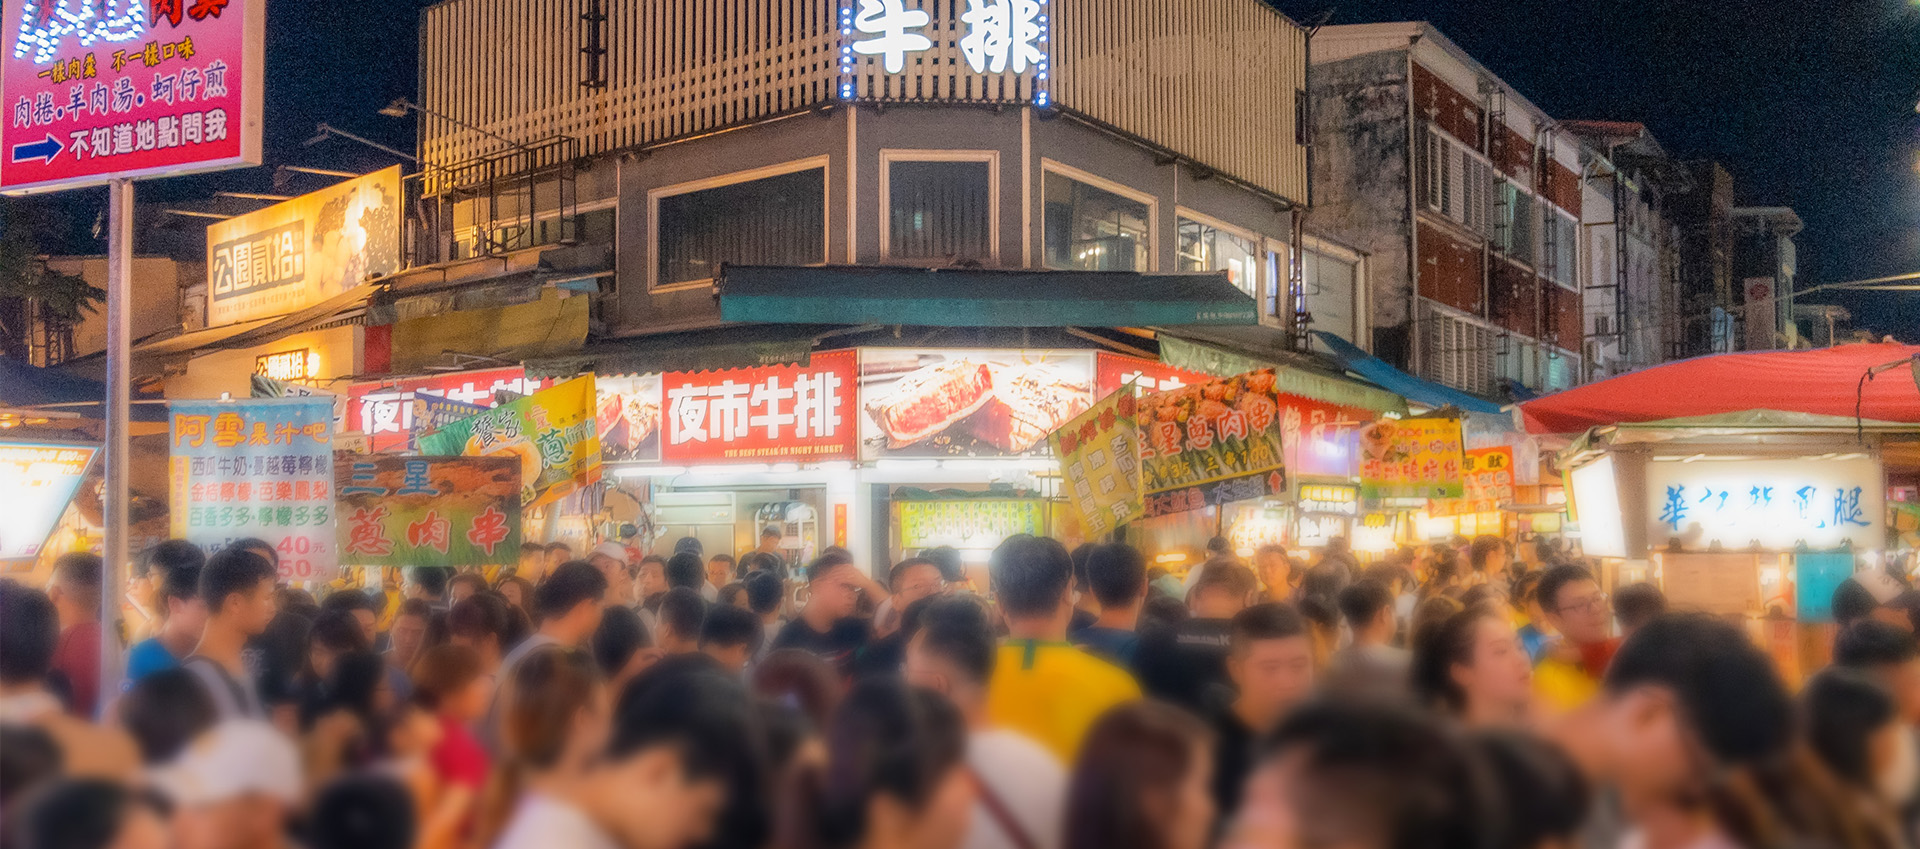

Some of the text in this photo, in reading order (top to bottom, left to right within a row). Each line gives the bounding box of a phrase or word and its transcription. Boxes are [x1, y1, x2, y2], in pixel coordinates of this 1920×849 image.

[38, 36, 196, 84] 一樣肉羹 不一樣口味
[852, 0, 1041, 74] 牛排
[69, 108, 227, 160] 不知道地點問我
[174, 412, 330, 448] 阿雪果汁吧
[668, 371, 842, 445] 夜市牛排
[724, 444, 844, 458] THE BEST STEAK IN NIGHT MARKET
[343, 460, 439, 497] 三星
[345, 506, 510, 556] 蔥肉串
